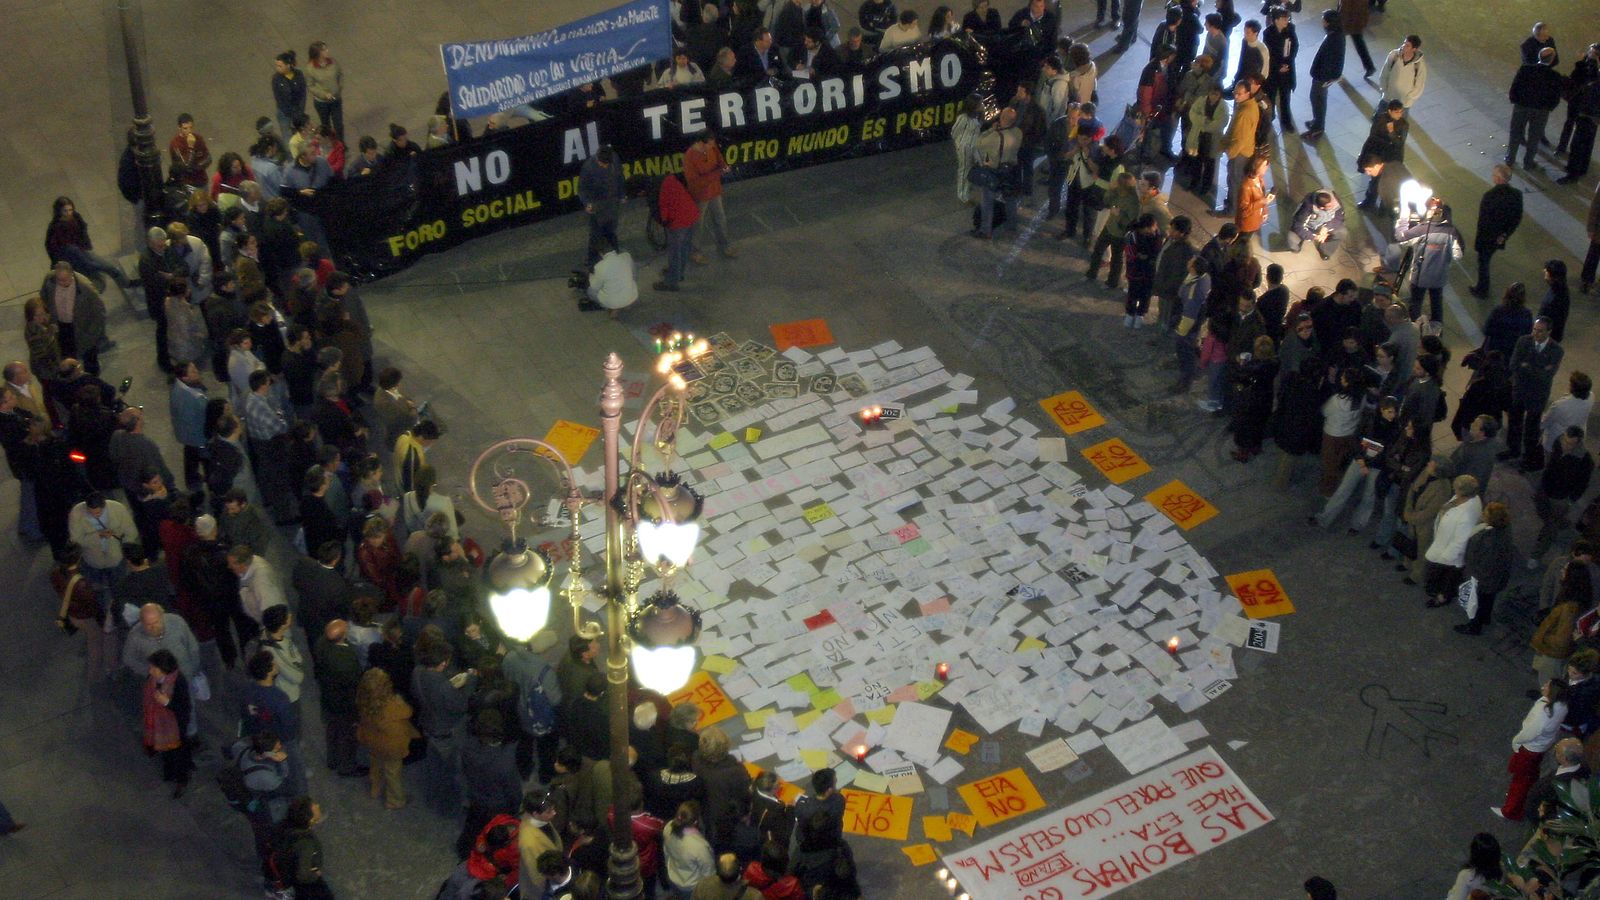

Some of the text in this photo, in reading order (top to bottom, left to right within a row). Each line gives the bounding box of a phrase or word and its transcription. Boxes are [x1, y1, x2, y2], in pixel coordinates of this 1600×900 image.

[454, 150, 511, 196] NO
[643, 53, 962, 140] TERRORISMO
[388, 219, 446, 257] FORO
[462, 190, 541, 228] SOCIAL
[725, 139, 779, 165] OTRO
[788, 125, 849, 156] MUNDO
[862, 117, 886, 141] ES
[1053, 401, 1079, 426] ETA
[1070, 400, 1093, 420] NO
[1091, 452, 1116, 472] ETA
[1109, 445, 1138, 468] NO
[1162, 494, 1193, 522] ETA
[1177, 493, 1206, 513] NO
[1236, 584, 1259, 607] ETA
[1256, 580, 1283, 605] NO
[695, 681, 725, 715] ETA
[974, 776, 1018, 798] ETA
[1172, 762, 1225, 790] QUE
[845, 793, 894, 815] ETA
[986, 796, 1027, 817] NO
[1187, 784, 1246, 815] HACE
[852, 814, 890, 835] NO
[1065, 808, 1112, 836] CULO
[1073, 802, 1269, 896] LAS BOMBAS
[1021, 868, 1038, 881] NO
